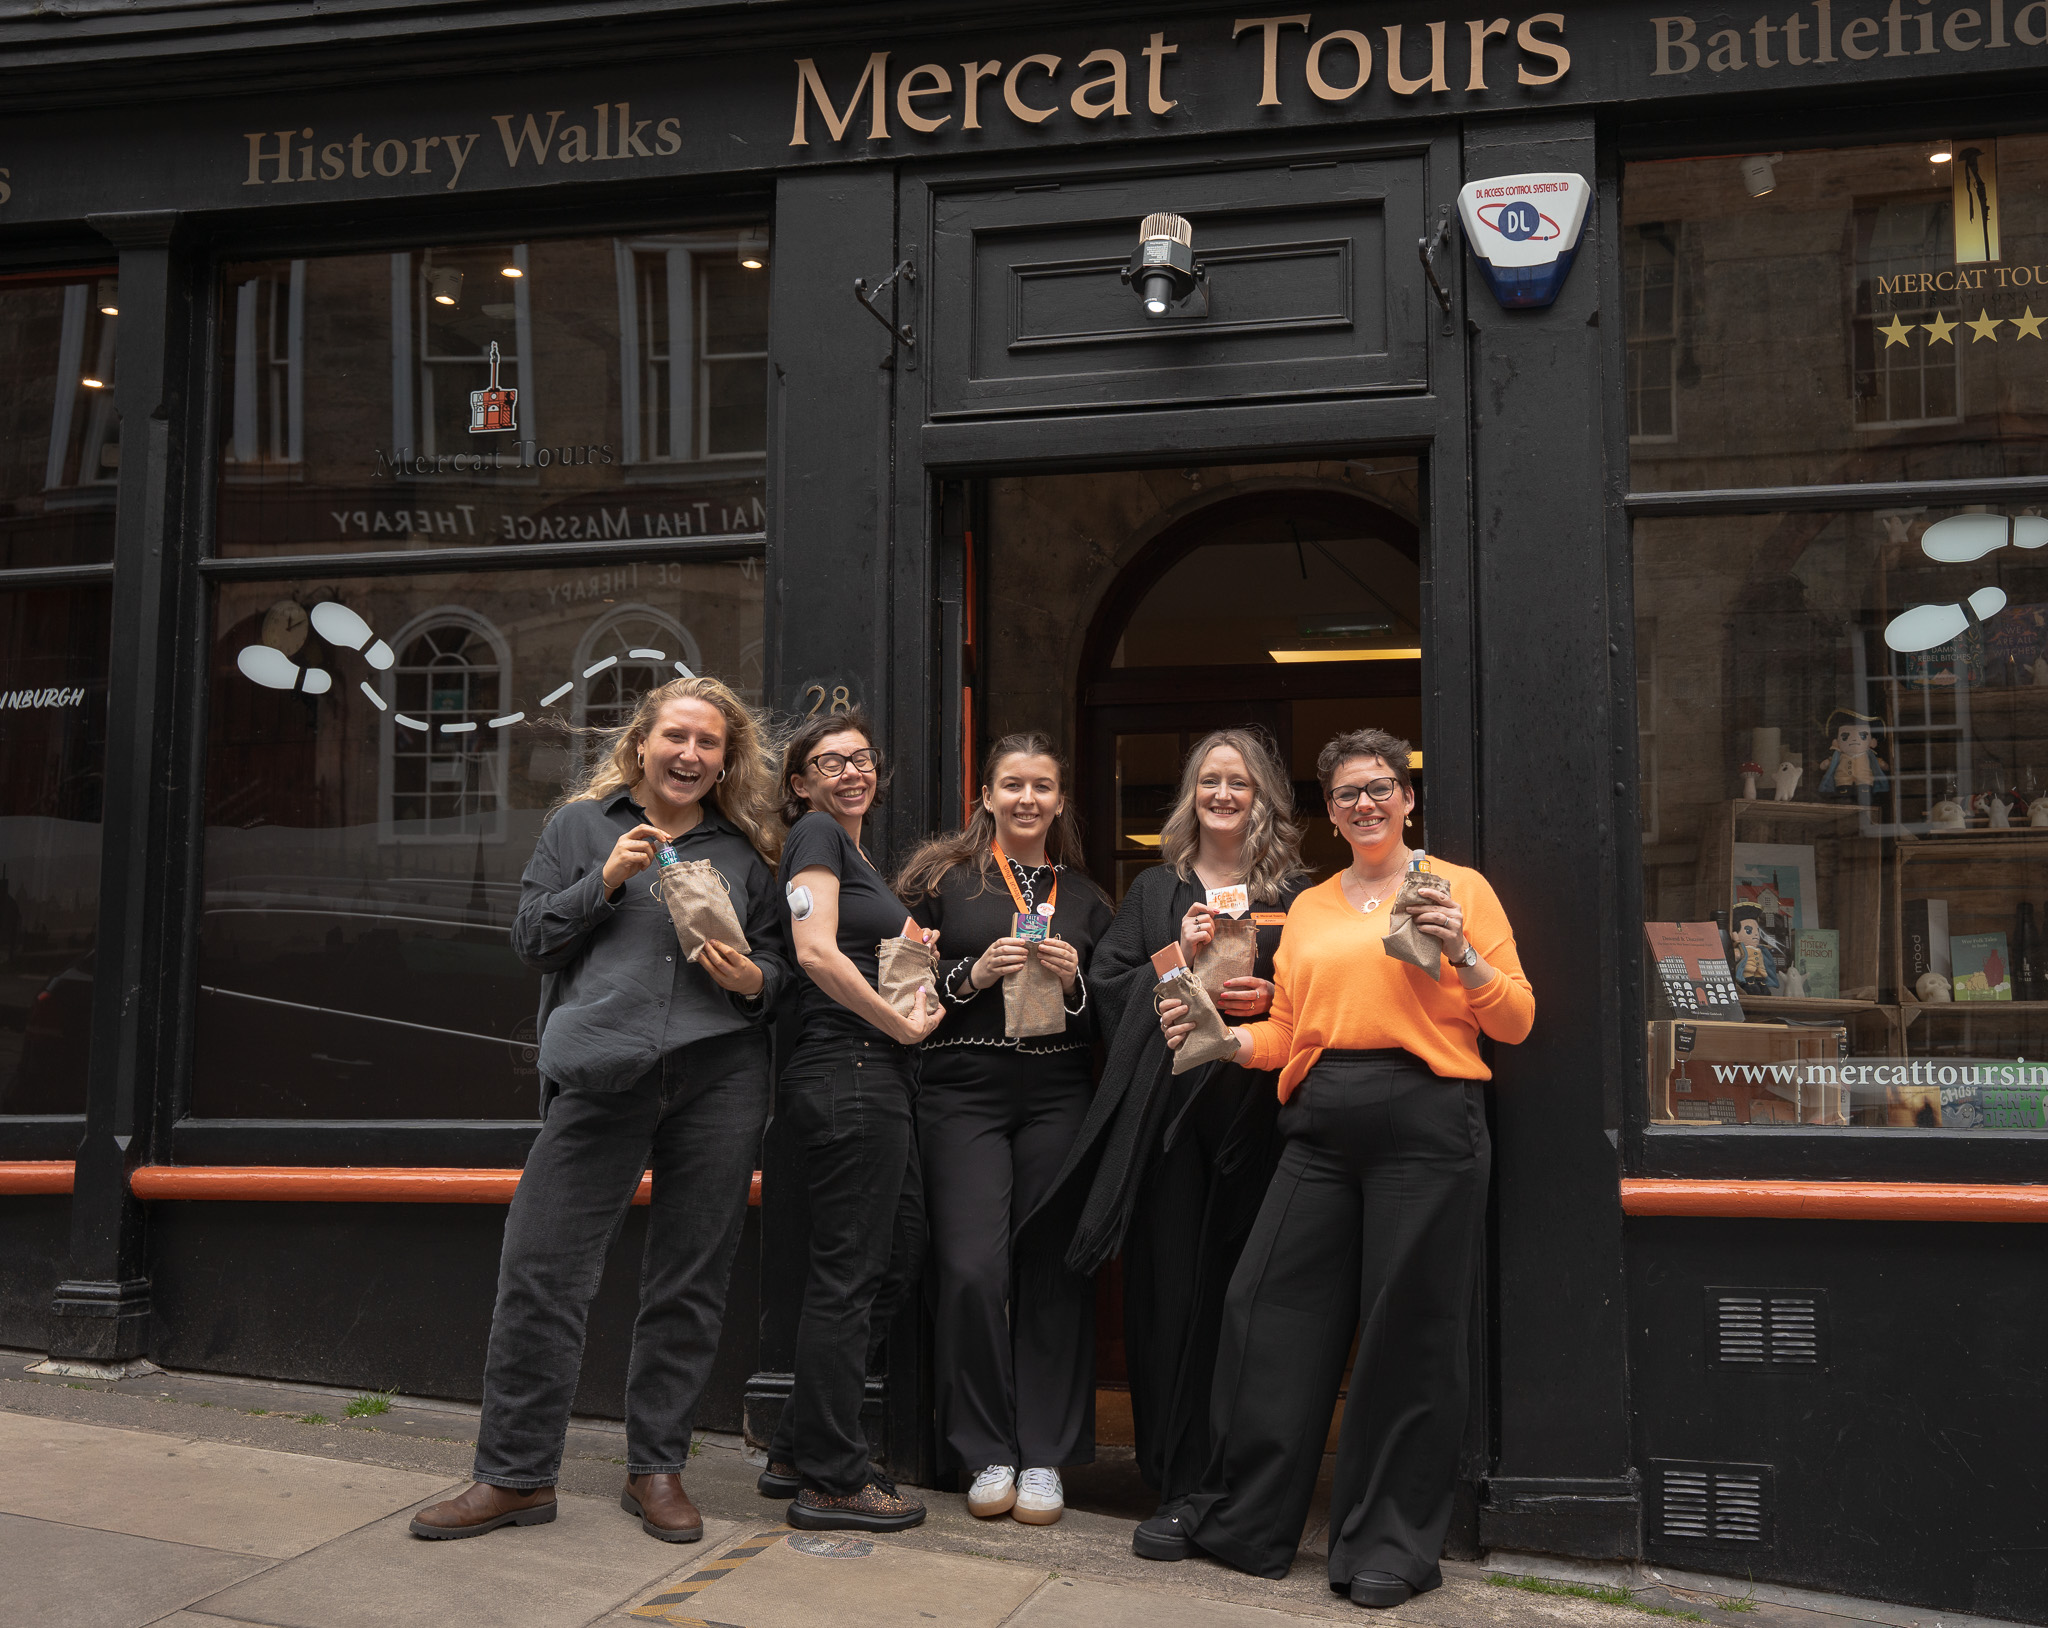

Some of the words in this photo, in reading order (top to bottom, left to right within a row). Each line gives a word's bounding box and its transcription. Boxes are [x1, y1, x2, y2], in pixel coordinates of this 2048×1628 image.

[1649, 0, 2048, 76] Battlefield
[789, 31, 1178, 146] Mercat
[1232, 12, 1571, 106] Tours
[242, 127, 480, 190] History
[491, 102, 682, 168] Walks
[1476, 189, 1483, 199] DL
[1484, 187, 1504, 198] ACCESS
[1505, 185, 1532, 196] CONTROL
[1533, 183, 1558, 194] SYSTEMS
[1559, 182, 1569, 192] LTD
[1507, 210, 1530, 233] DL
[1877, 269, 1987, 295] MERCAT
[1879, 291, 2042, 309] INTERNATIONAL
[371, 446, 504, 478] Mercat
[511, 440, 615, 468] Tours
[2006, 626, 2021, 634] WE
[1931, 646, 1957, 654] DAMN
[1996, 638, 2013, 646] ARE
[1918, 655, 1939, 663] REBEL
[1941, 653, 1971, 662] BITCHES
[0, 687, 85, 709] INBURGH
[805, 685, 851, 720] 28
[1800, 939, 1827, 949] MYSTERY
[1800, 948, 1832, 959] MANSION
[513, 1066, 537, 1076] tripad
[1940, 1085, 1979, 1106] GHOST
[1982, 1092, 2040, 1110] CAN'T
[1982, 1110, 2039, 1128] DRAW
